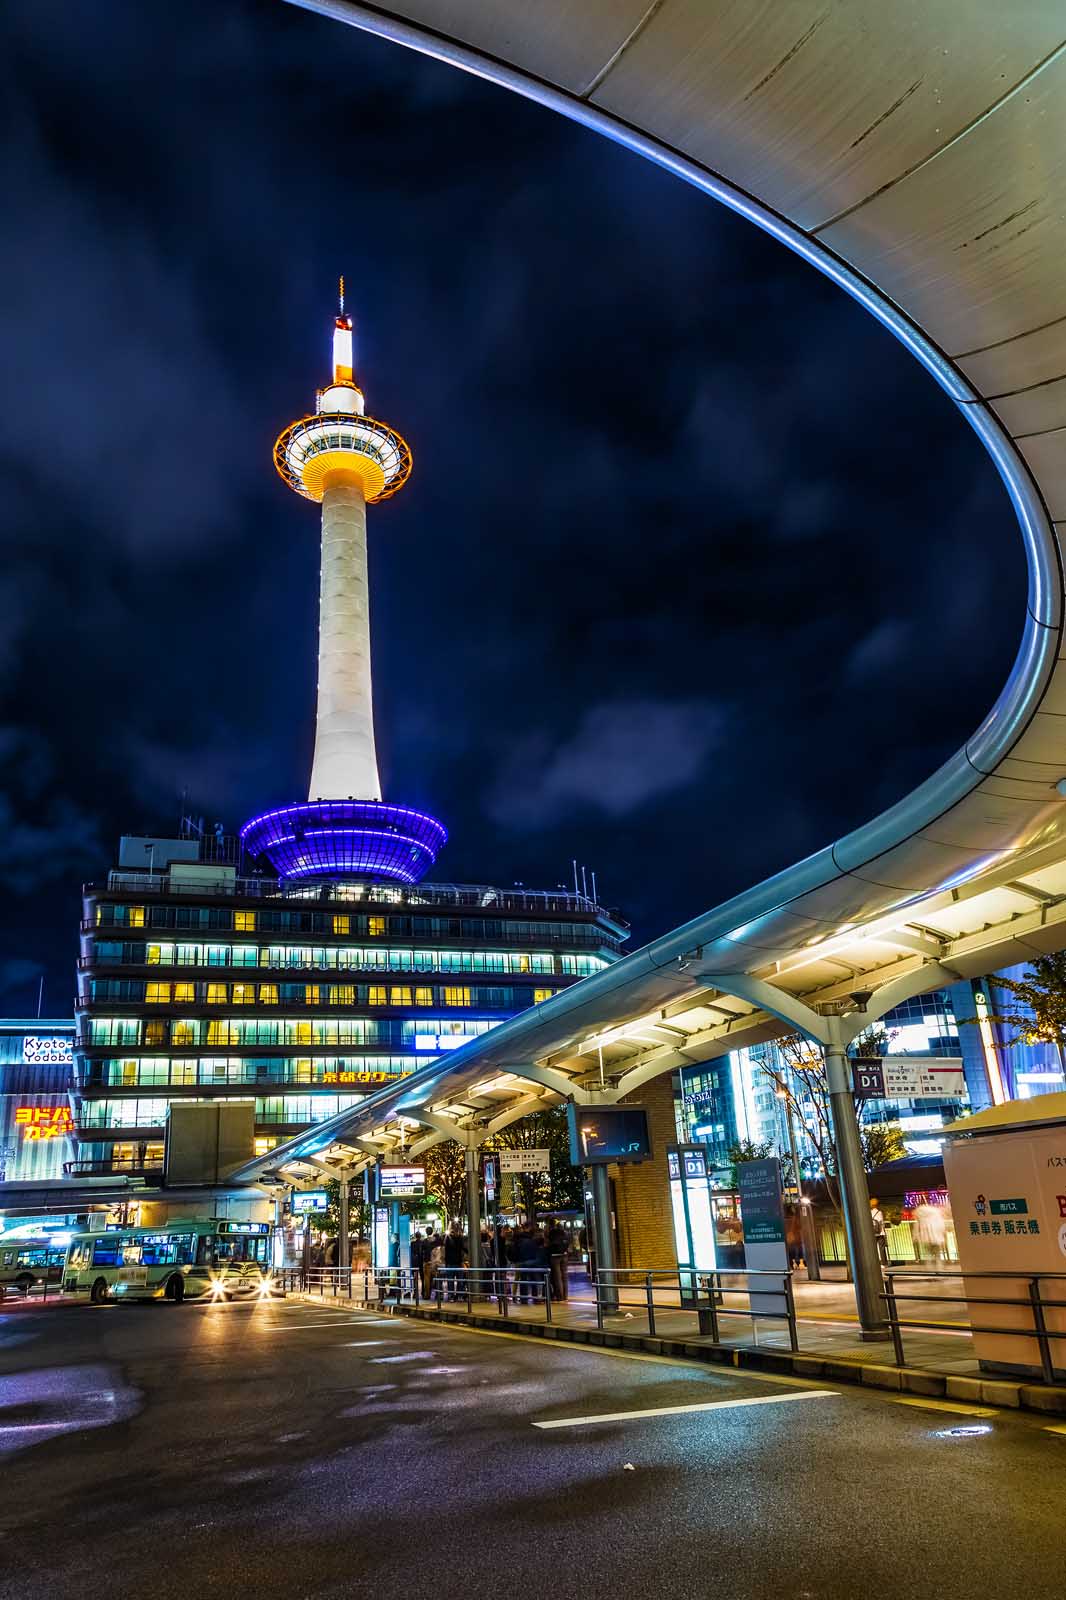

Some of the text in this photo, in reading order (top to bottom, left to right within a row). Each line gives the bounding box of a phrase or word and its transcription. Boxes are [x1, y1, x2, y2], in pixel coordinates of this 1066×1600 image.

[24, 1038, 73, 1050] Kyoto-
[861, 1075, 878, 1087] D1
[15, 1107, 70, 1123] ヨドバ
[688, 1162, 703, 1173] D1
[1047, 1157, 1066, 1168] バス
[969, 1219, 1040, 1235] 乗車券 販売機
